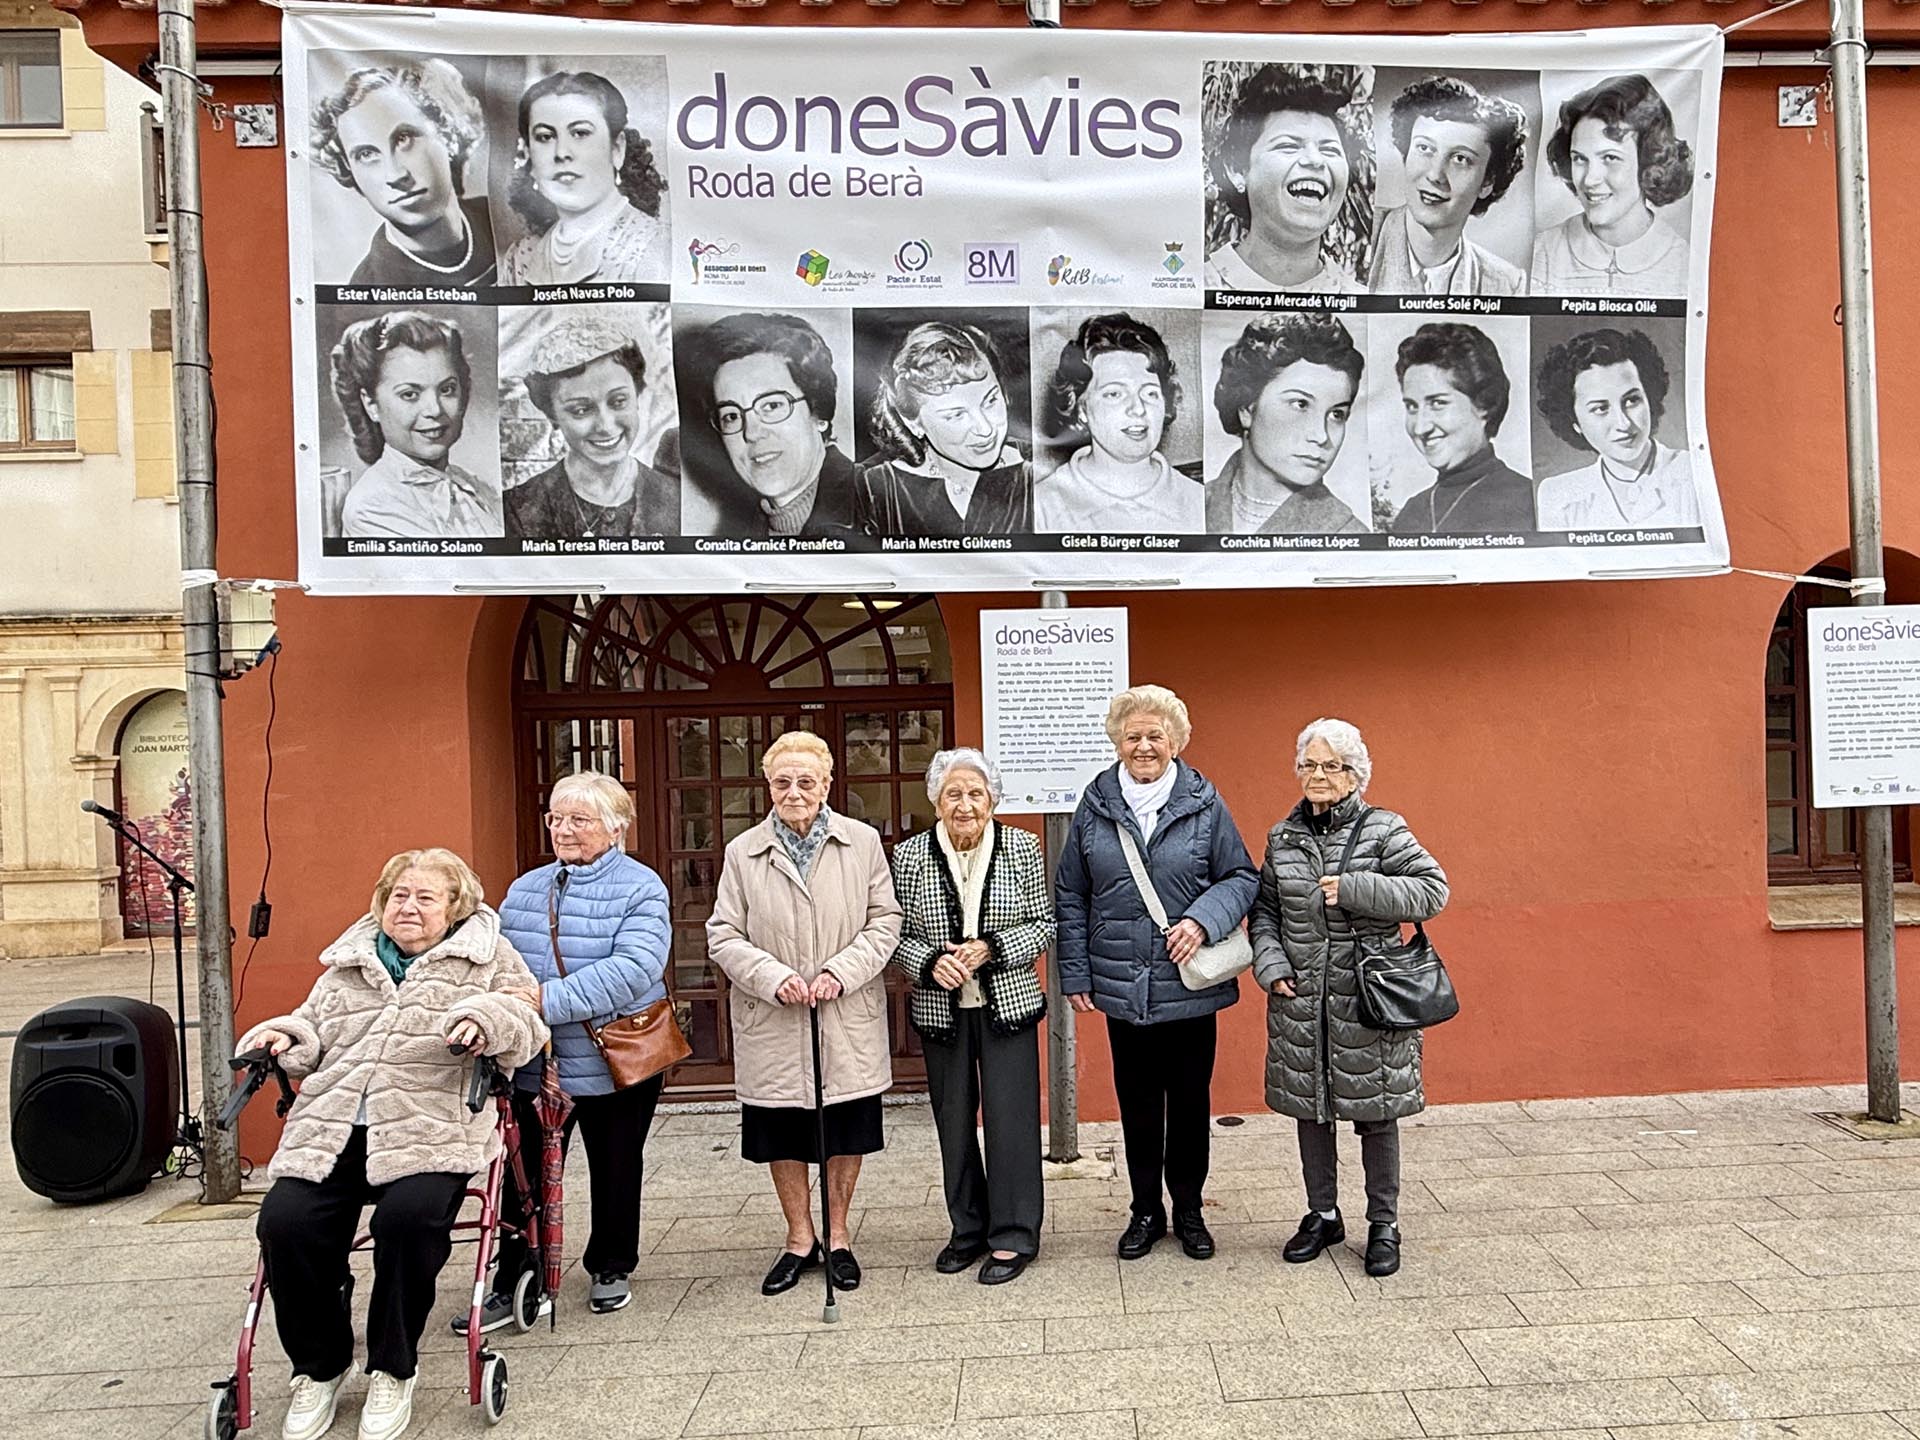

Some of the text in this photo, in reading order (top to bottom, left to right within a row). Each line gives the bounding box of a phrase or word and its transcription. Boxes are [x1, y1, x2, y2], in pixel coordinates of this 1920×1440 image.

[676, 66, 1183, 159] doneSàvies
[687, 164, 923, 198] Roda de Berà
[968, 249, 1015, 278] 8M
[887, 274, 911, 283] Pacte
[336, 287, 478, 302] Ester València Esteban
[532, 285, 637, 302] Josefa Navas Polo
[1213, 291, 1358, 311] Esperança Mercadé Virgili
[1398, 297, 1501, 314] Lourdes Solé Pujol
[1561, 298, 1658, 314] Pepita Biosca Ollé
[347, 539, 484, 553] Emilia Santiño Solano
[522, 538, 665, 552] Maria Teresa Riera Barot
[694, 537, 846, 552] Conxita Carnicé Prenafeta
[881, 537, 917, 550] Maria
[918, 537, 960, 550] Mestre
[1061, 534, 1181, 551] Gisela Bürger Glaser
[1220, 535, 1361, 550] Conchita Martínez López
[1387, 535, 1526, 550] Roser Domínguez Sendra
[1567, 530, 1675, 546] Pepita Coca Bonan
[995, 622, 1114, 645] doneSàvies
[1823, 619, 1920, 642] doneSàvie
[997, 645, 1053, 656] Roda de Berà
[132, 744, 191, 753] JOAN MARTO
